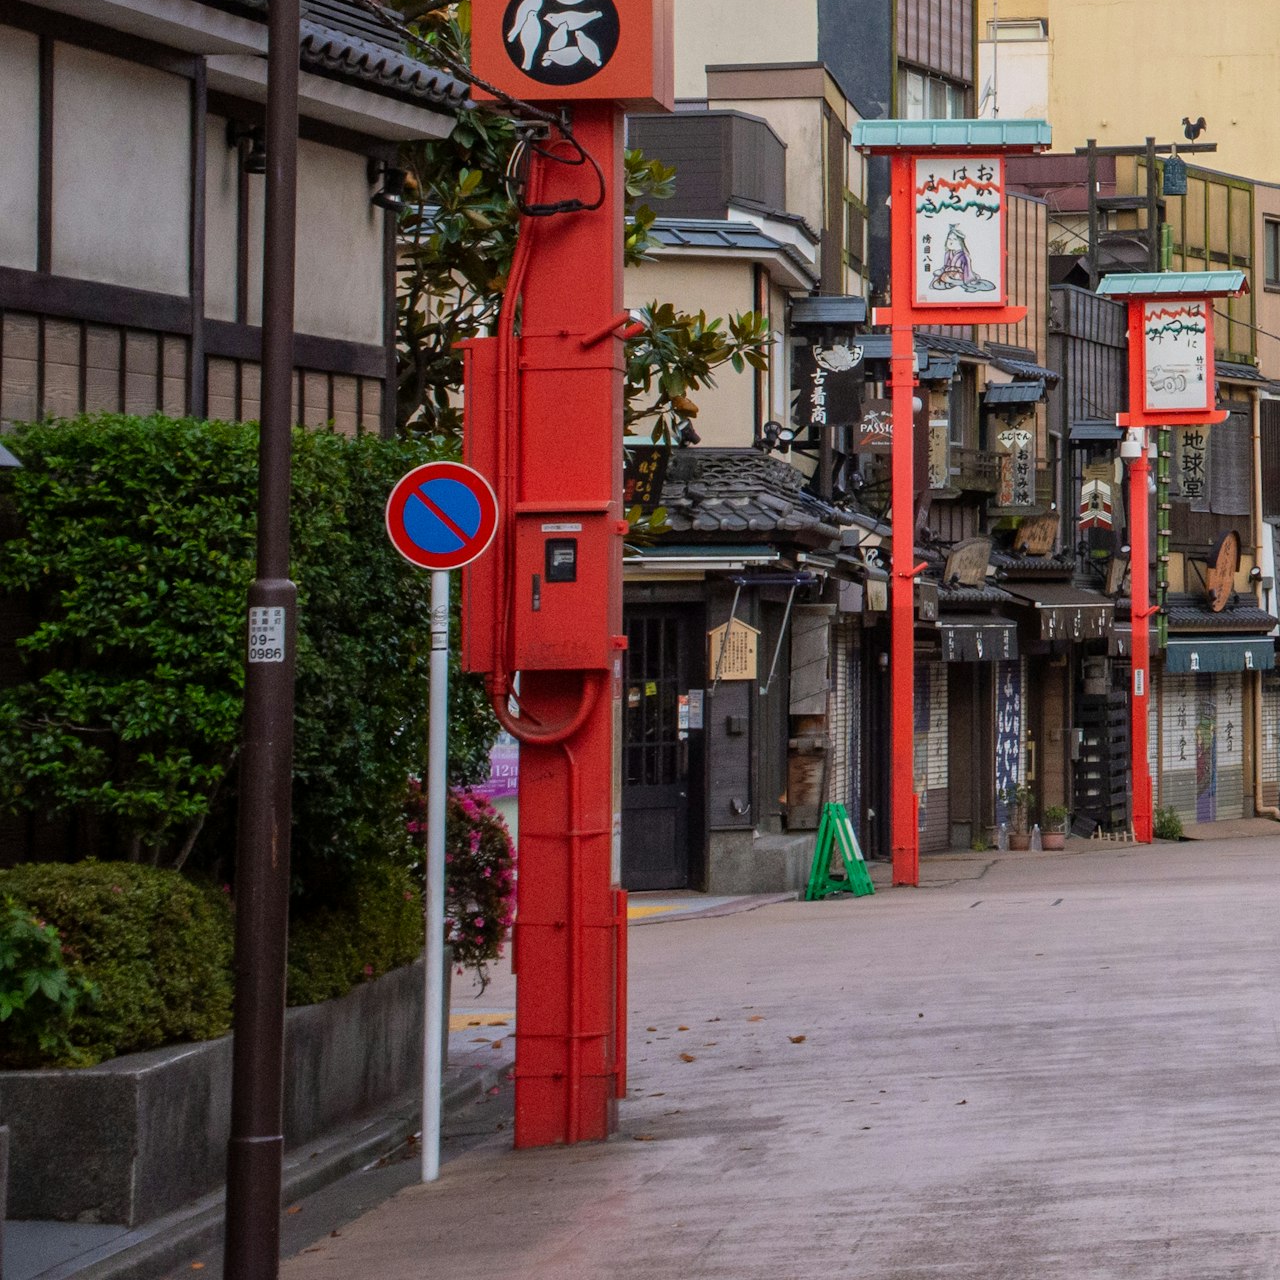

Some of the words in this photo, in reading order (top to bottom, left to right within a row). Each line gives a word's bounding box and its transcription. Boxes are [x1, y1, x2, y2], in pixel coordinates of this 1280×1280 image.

[949, 165, 968, 205] はち
[975, 163, 994, 221] おかめ
[1016, 450, 1031, 504] お好み焼
[1182, 430, 1206, 499] 地球堂
[250, 634, 275, 646] 09-
[250, 648, 282, 659] 0986
